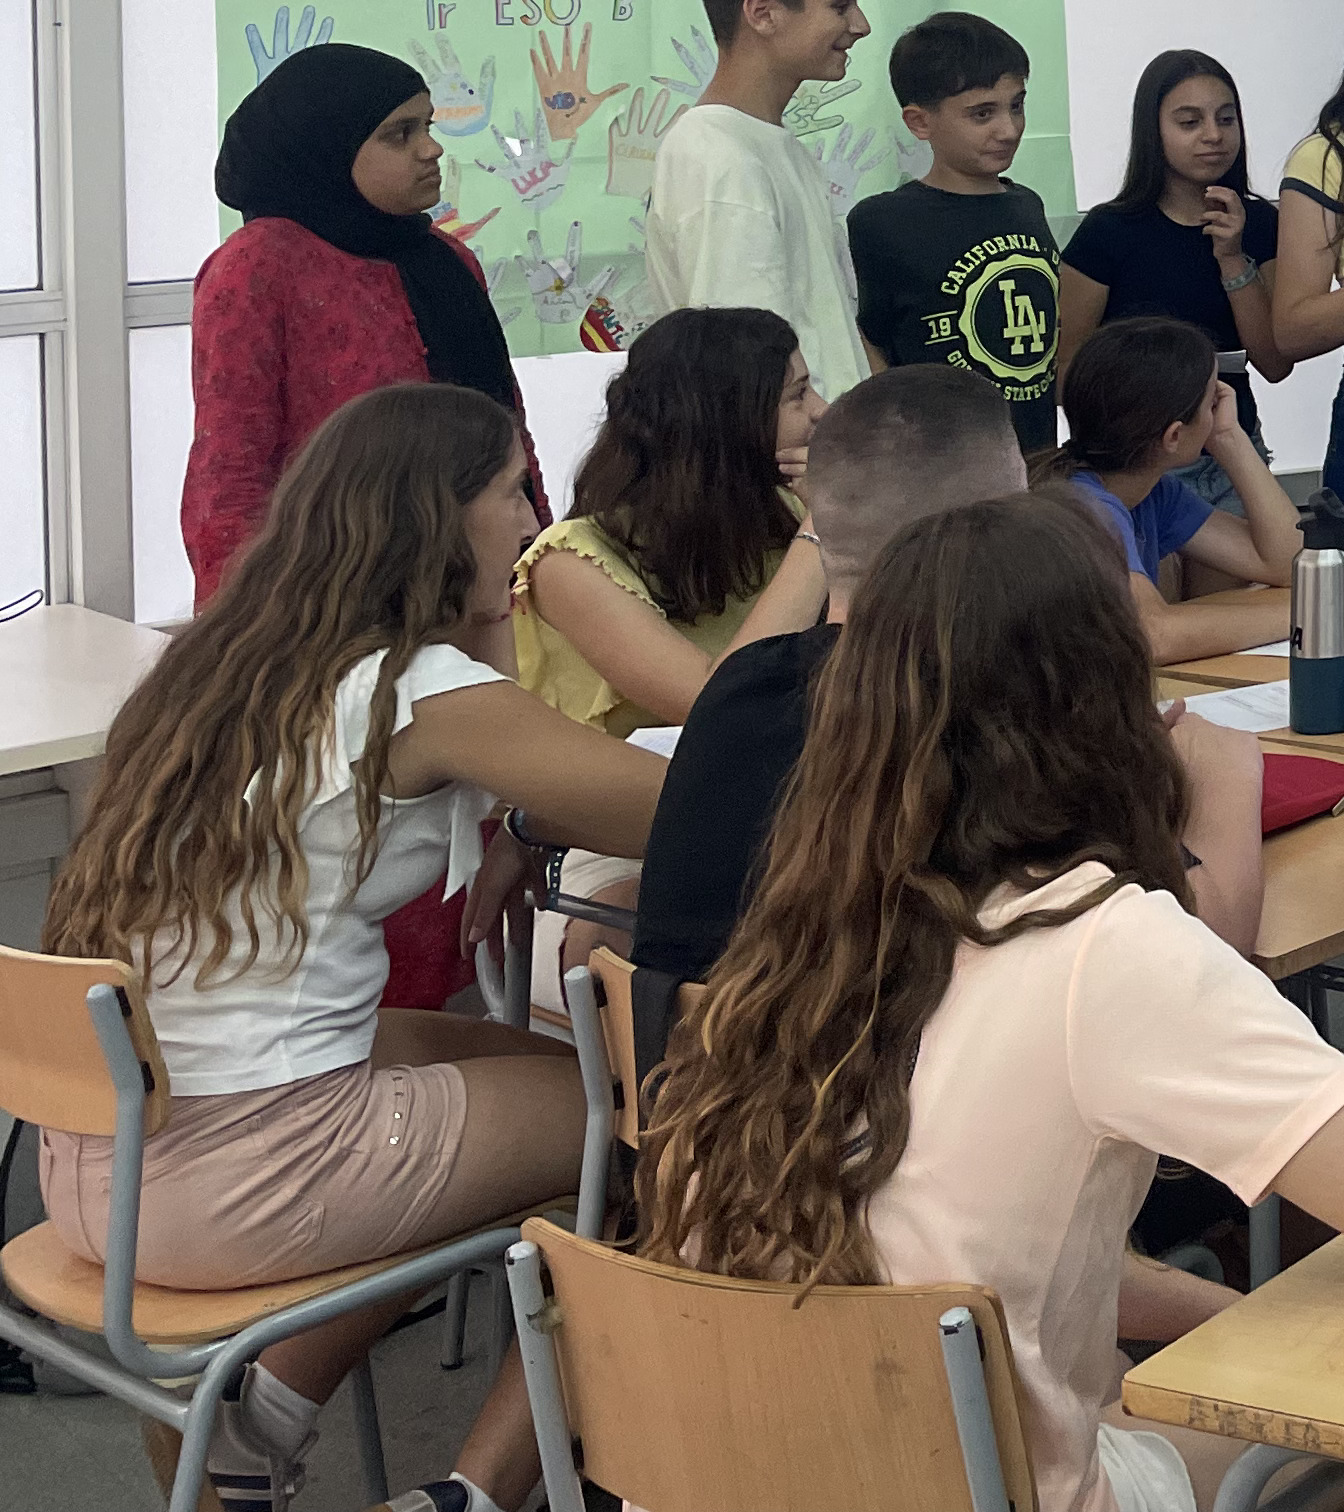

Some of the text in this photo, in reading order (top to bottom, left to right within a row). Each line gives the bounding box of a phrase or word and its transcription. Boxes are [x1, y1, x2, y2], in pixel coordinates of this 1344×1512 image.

[940, 234, 1041, 295] CALIFORNIA
[927, 317, 952, 339] 19
[998, 279, 1047, 355] LA
[1003, 385, 1041, 401] STATE
